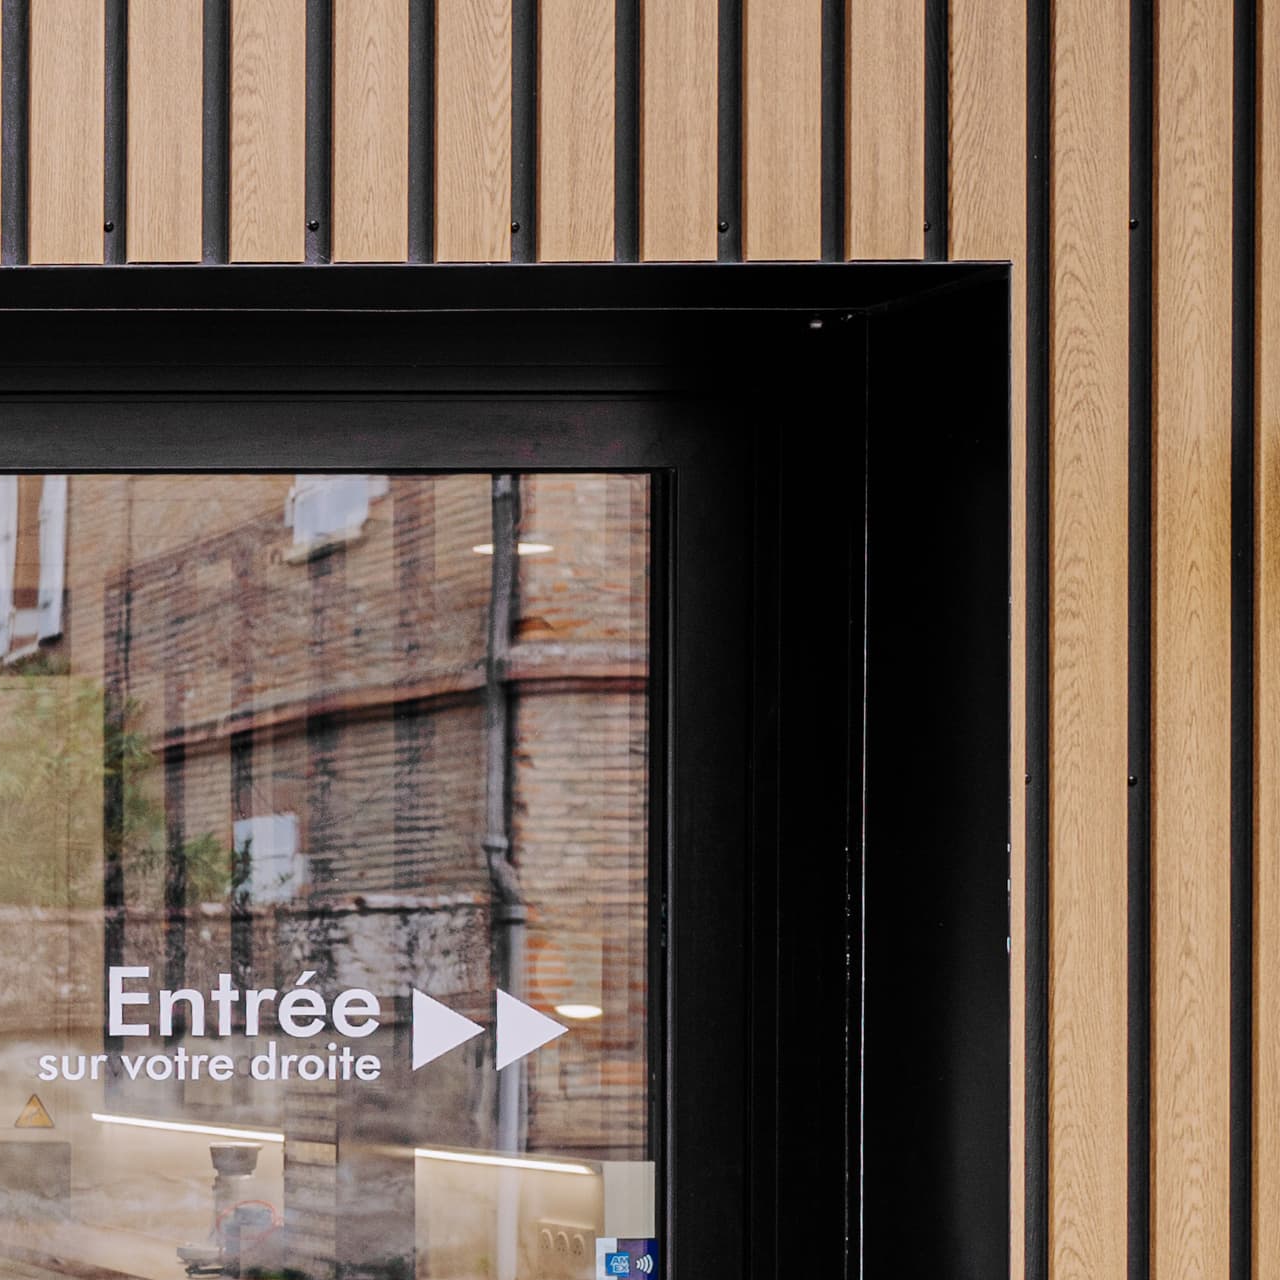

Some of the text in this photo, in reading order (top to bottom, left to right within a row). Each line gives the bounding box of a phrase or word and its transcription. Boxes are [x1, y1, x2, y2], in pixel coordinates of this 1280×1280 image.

[108, 966, 381, 1037] Entrée
[38, 1043, 381, 1081] sur votre droite
